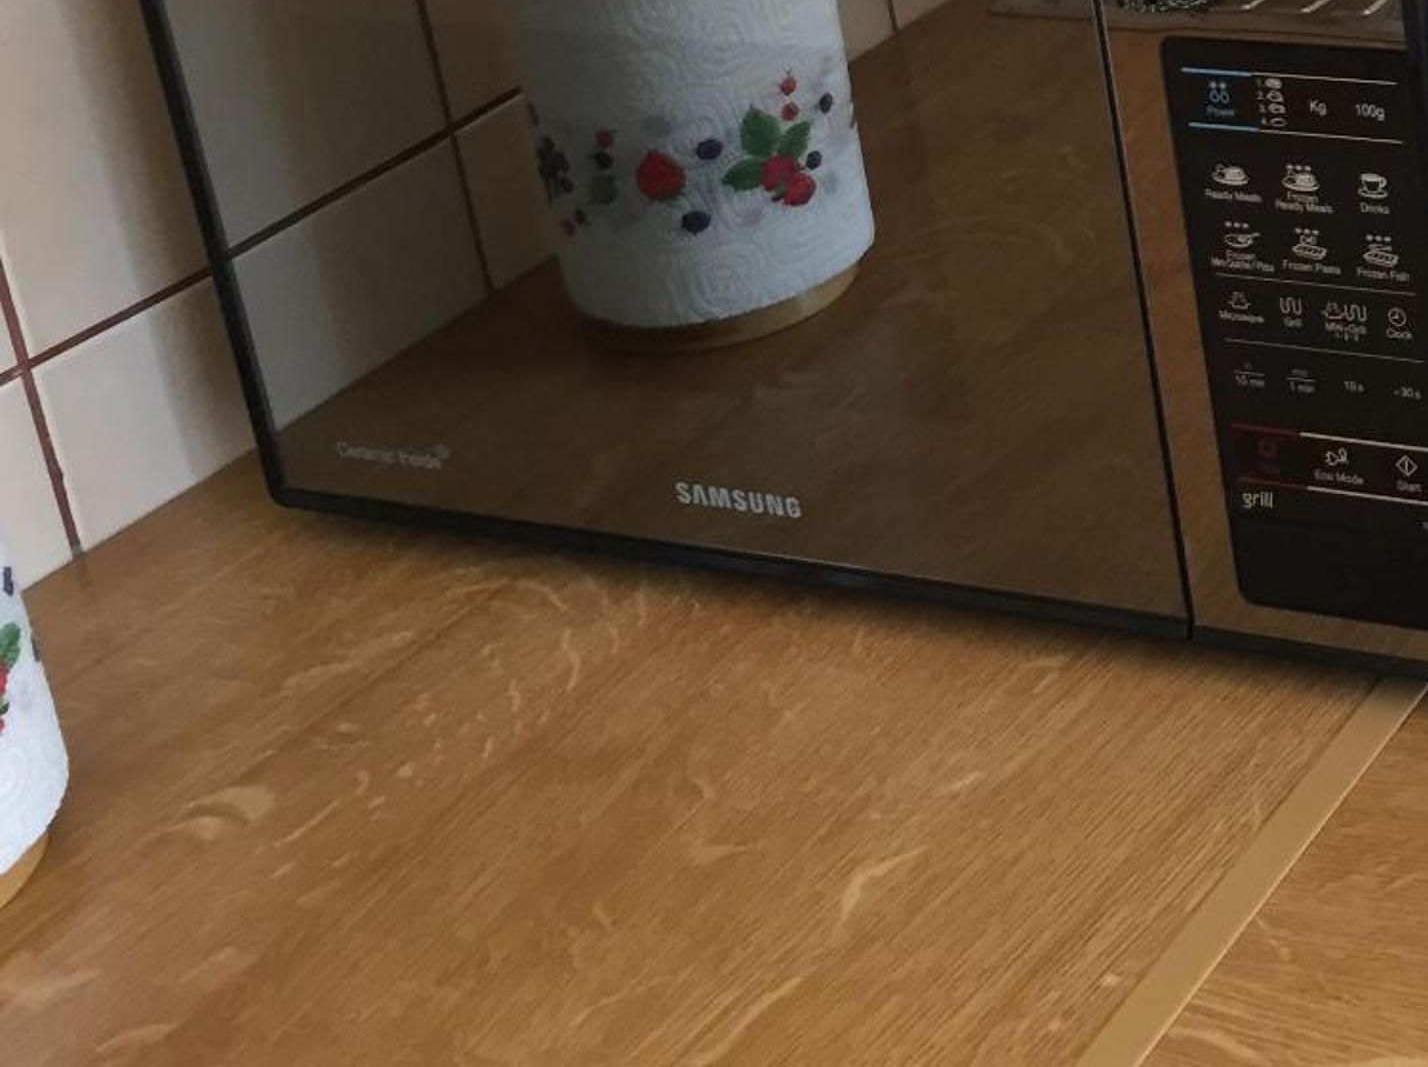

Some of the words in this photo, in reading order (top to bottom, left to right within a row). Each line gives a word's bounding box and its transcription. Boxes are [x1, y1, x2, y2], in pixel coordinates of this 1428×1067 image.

[1355, 104, 1386, 121] 100g
[675, 481, 802, 519] SAMSUNG
[1242, 491, 1274, 509] grill
